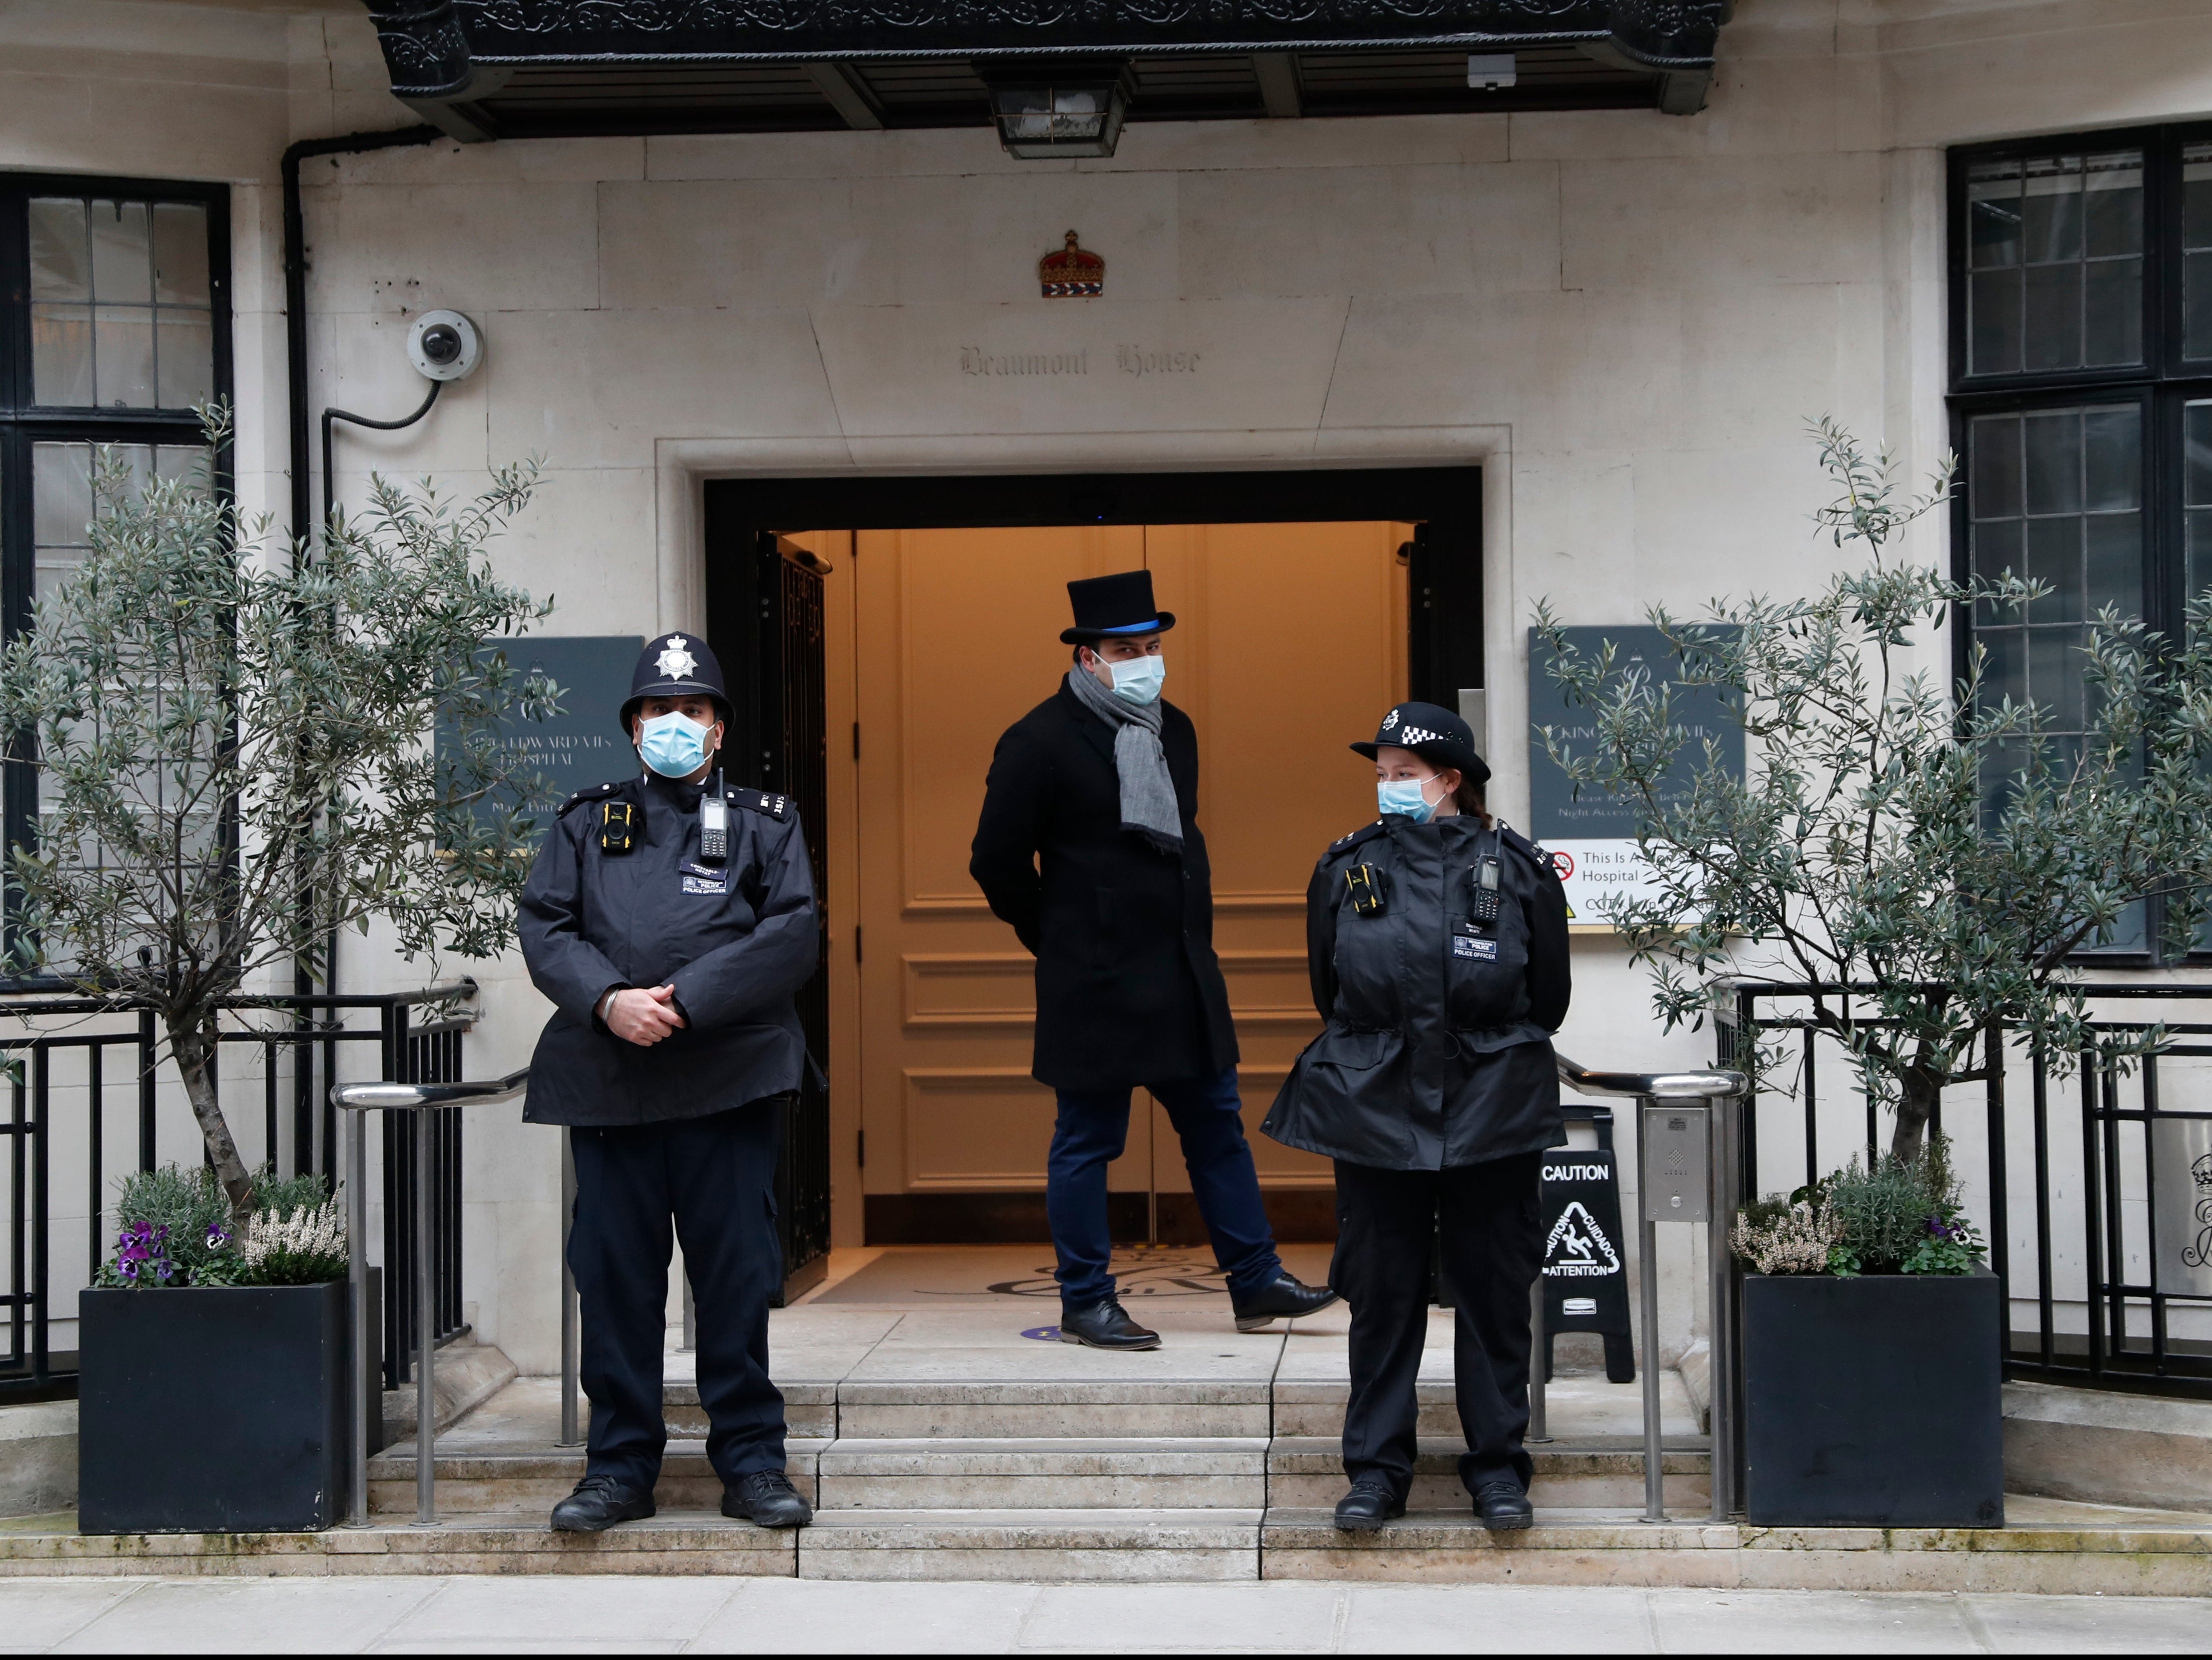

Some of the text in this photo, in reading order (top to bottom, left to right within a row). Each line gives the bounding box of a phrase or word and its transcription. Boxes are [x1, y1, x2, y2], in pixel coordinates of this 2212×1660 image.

[510, 737, 578, 749] EDWARD
[1558, 808, 1588, 819] Night
[1583, 851, 1610, 863] This
[1615, 851, 1625, 863] Is
[1629, 852, 1640, 863] A
[1583, 869, 1638, 884] Hospital
[1542, 1165, 1609, 1181] CAUTION
[1583, 1215, 1615, 1258] CUIDADO
[1549, 1266, 1607, 1276] ATTENTION
